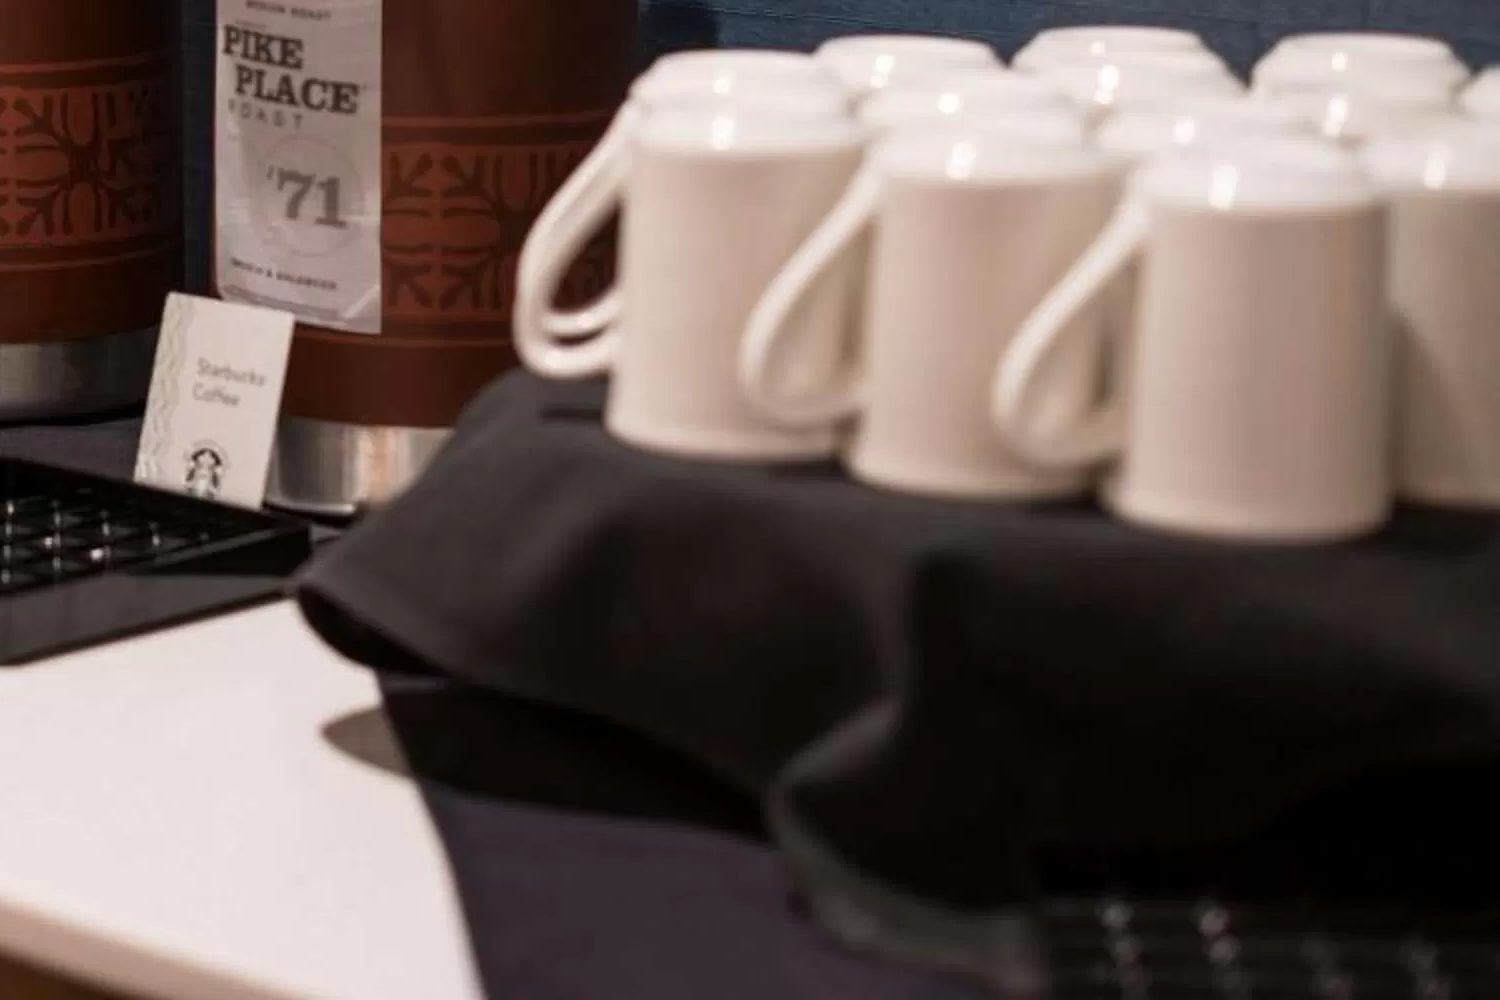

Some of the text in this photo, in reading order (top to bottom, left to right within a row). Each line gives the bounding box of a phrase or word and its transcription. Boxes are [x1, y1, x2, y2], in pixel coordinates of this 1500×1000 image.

[222, 24, 304, 70] PIKE
[235, 63, 360, 115] PLACE
[266, 163, 348, 230] '71
[192, 382, 241, 408] Coffee
[197, 356, 268, 388] Starbucks
